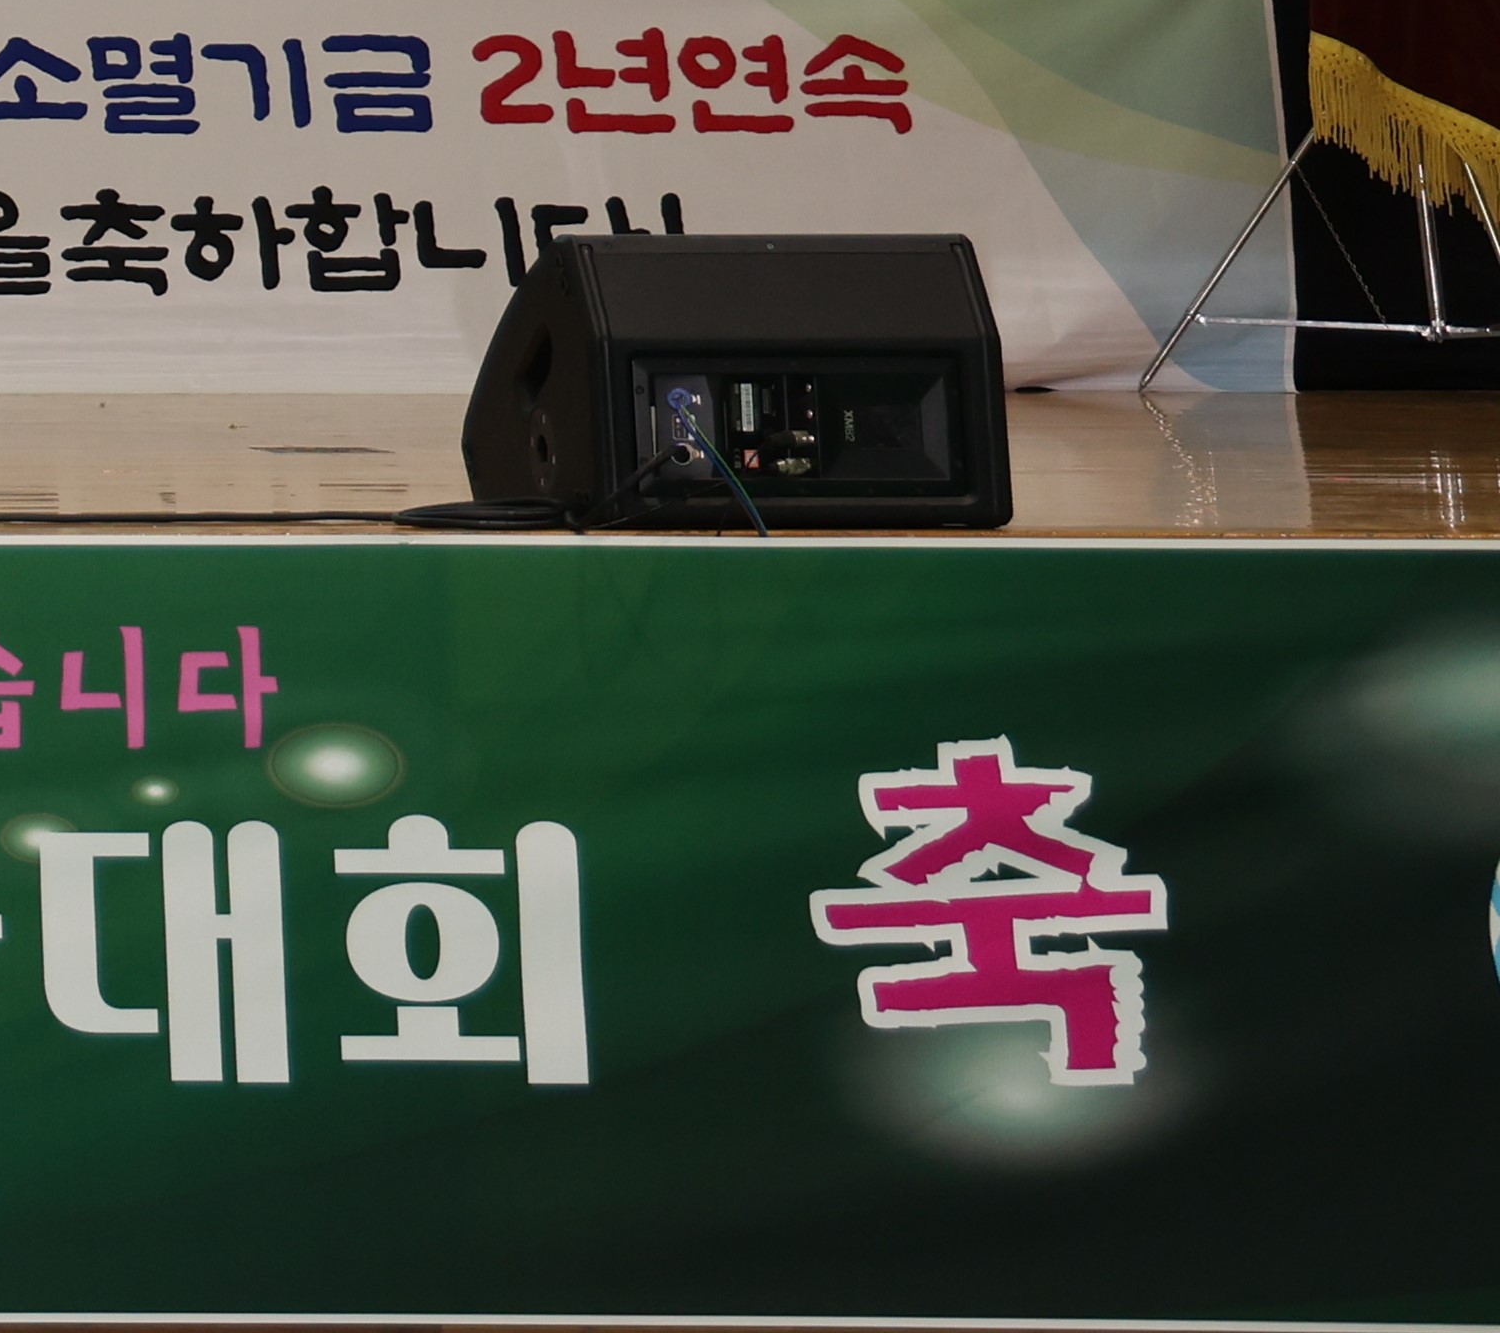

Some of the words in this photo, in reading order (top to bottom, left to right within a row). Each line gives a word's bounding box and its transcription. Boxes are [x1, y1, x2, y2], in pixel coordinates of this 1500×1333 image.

[472, 27, 913, 136] 2년연속
[844, 409, 855, 442] XM82
[808, 733, 1168, 1086] 축
